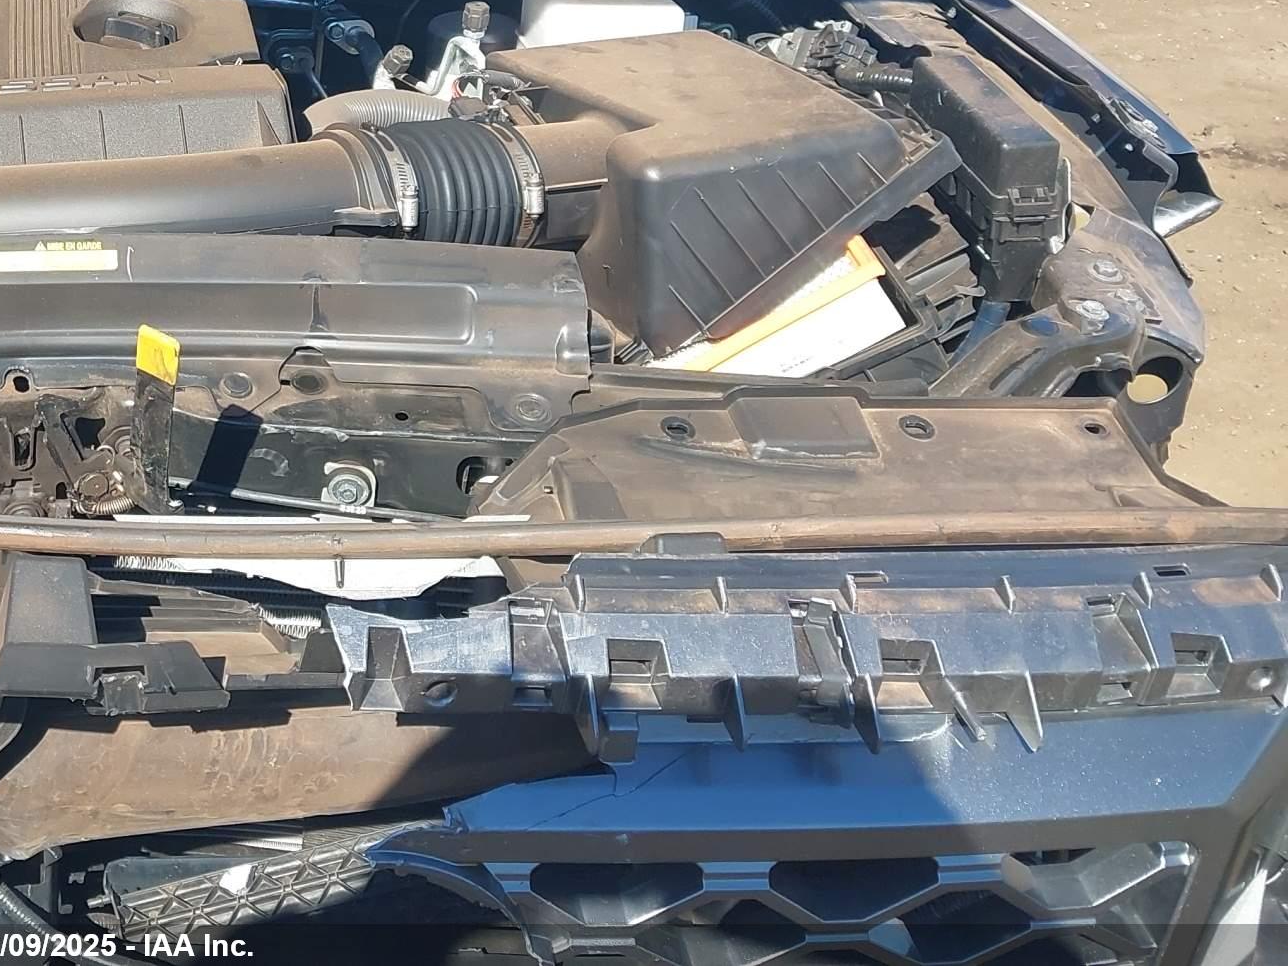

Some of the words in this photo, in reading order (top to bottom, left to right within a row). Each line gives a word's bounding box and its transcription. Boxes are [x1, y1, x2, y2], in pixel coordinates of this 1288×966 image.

[47, 241, 64, 251] MISE
[65, 241, 76, 250] EN
[76, 240, 102, 250] GARDE
